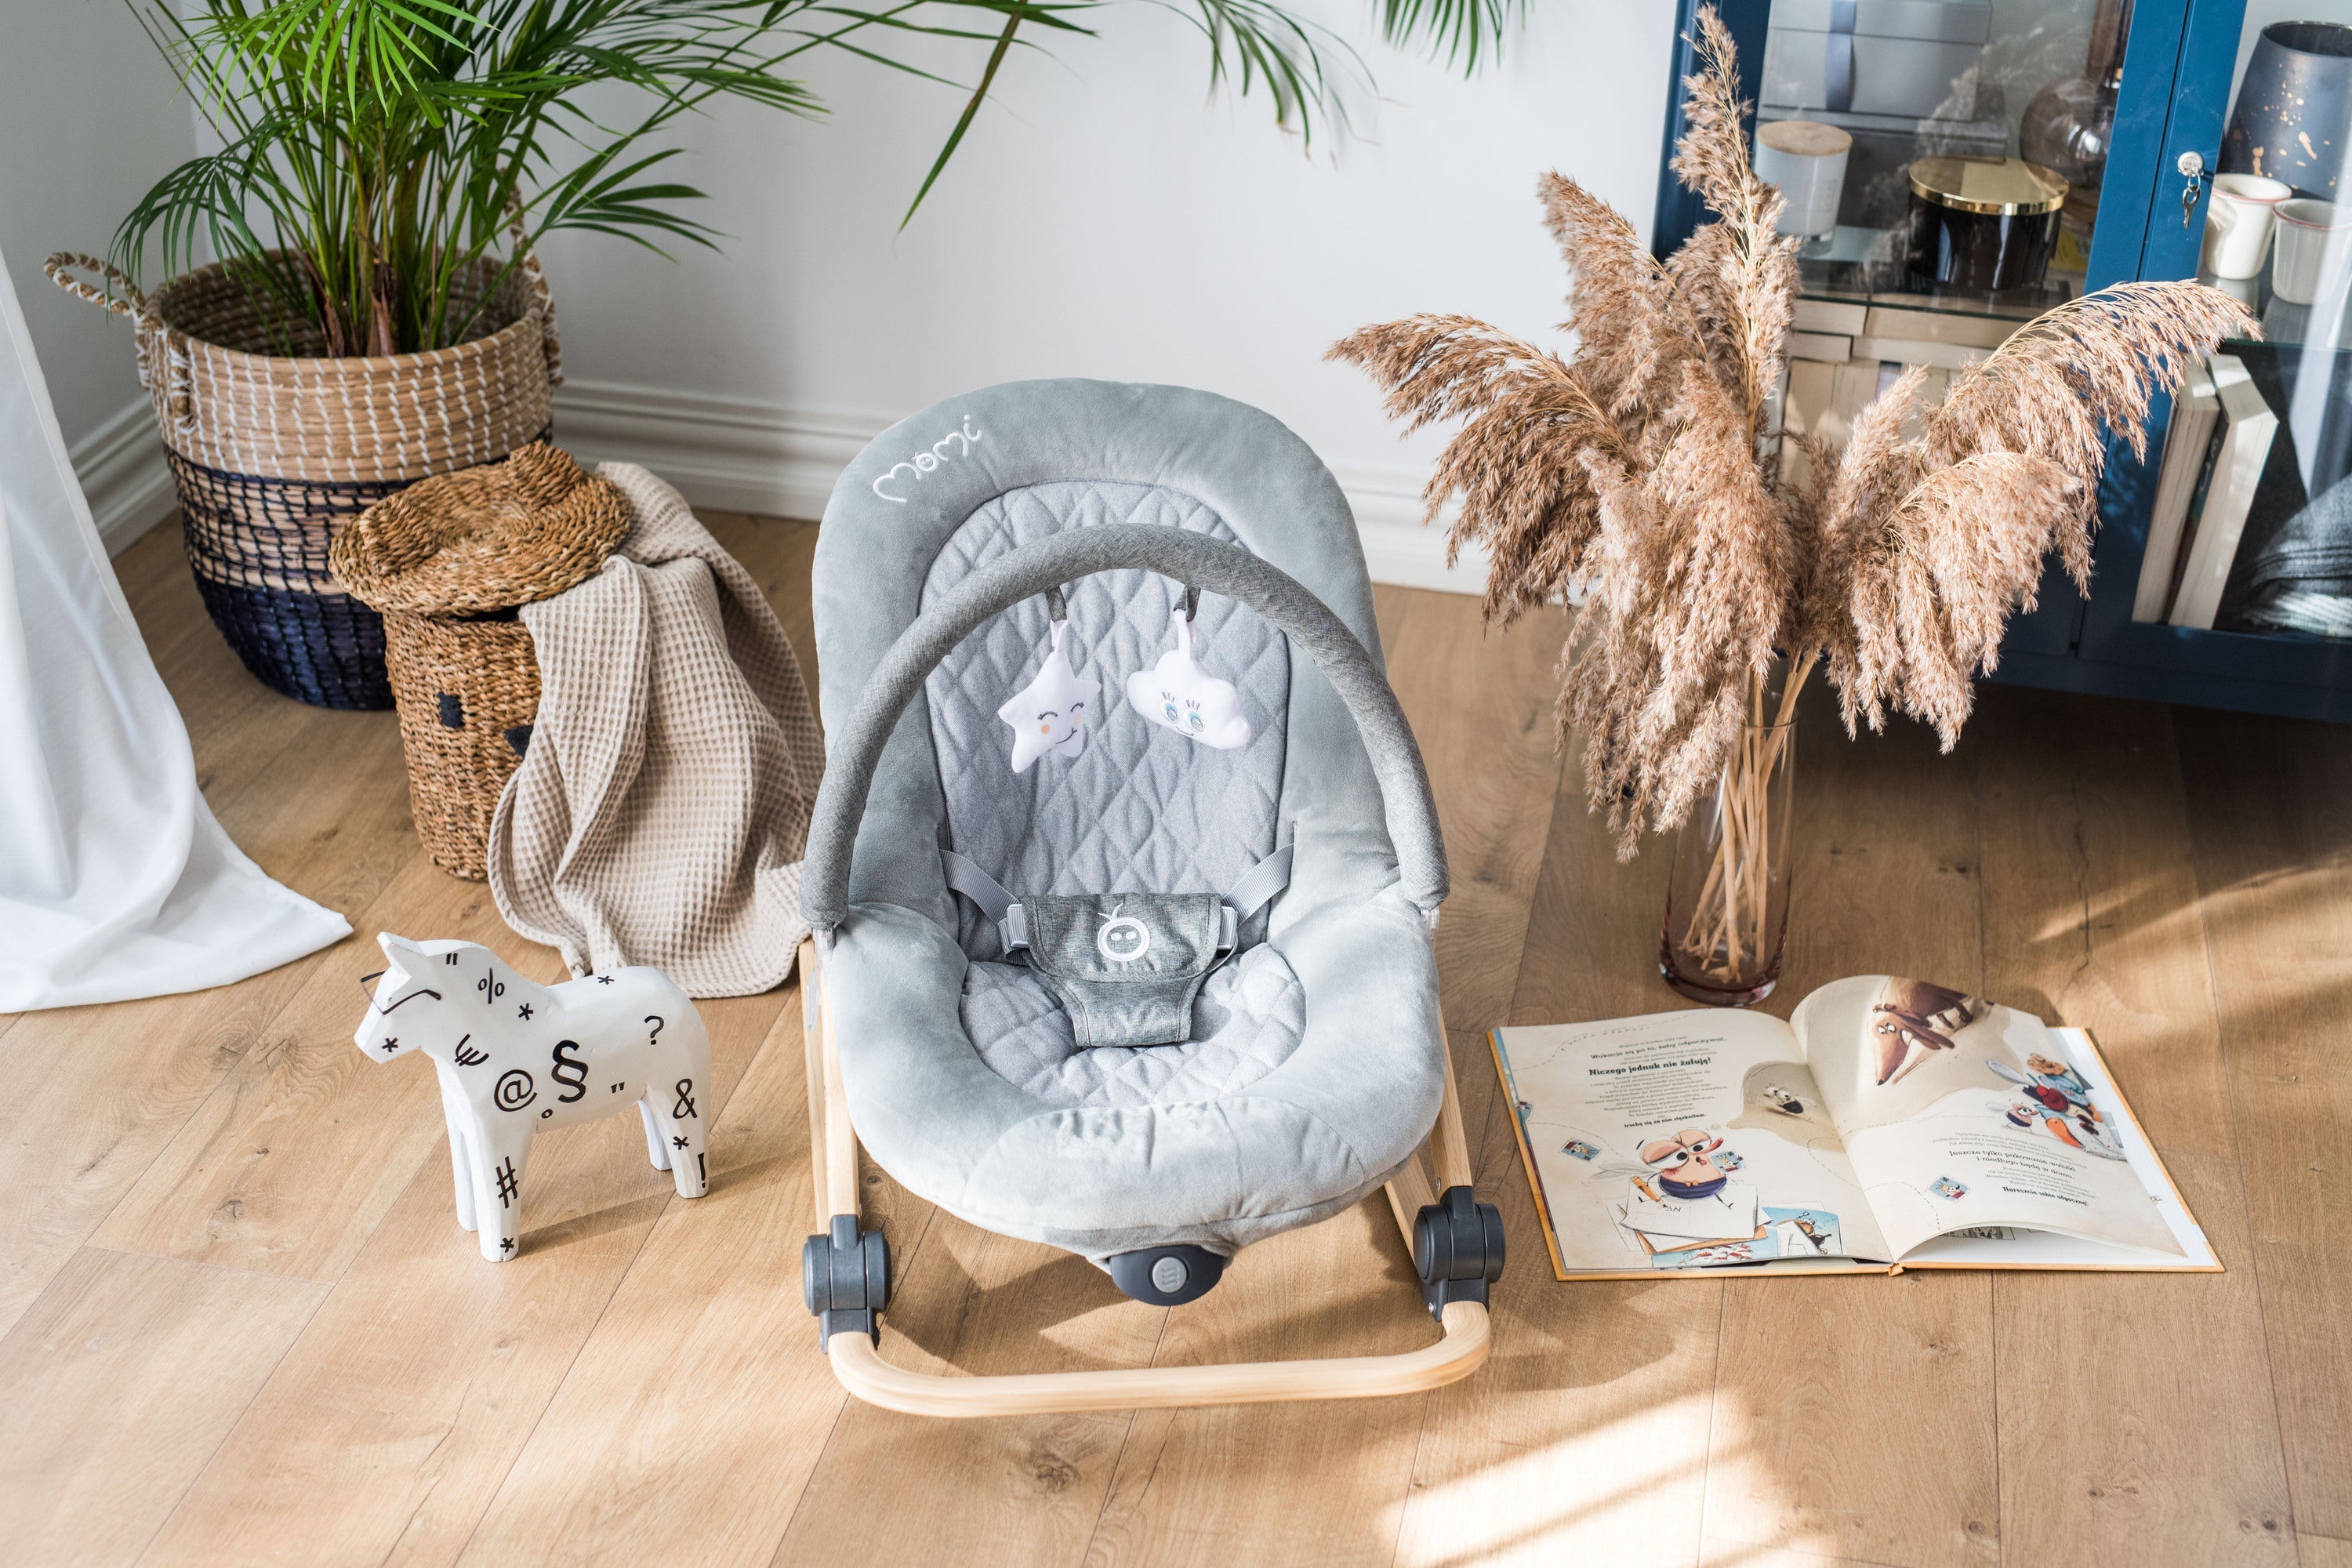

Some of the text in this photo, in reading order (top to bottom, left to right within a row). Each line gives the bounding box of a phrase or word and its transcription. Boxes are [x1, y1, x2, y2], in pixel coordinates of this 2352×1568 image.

[1588, 1067, 1626, 1076] Niczego
[1628, 1062, 1661, 1073] jednak
[1680, 1057, 1712, 1066] żałuję!
